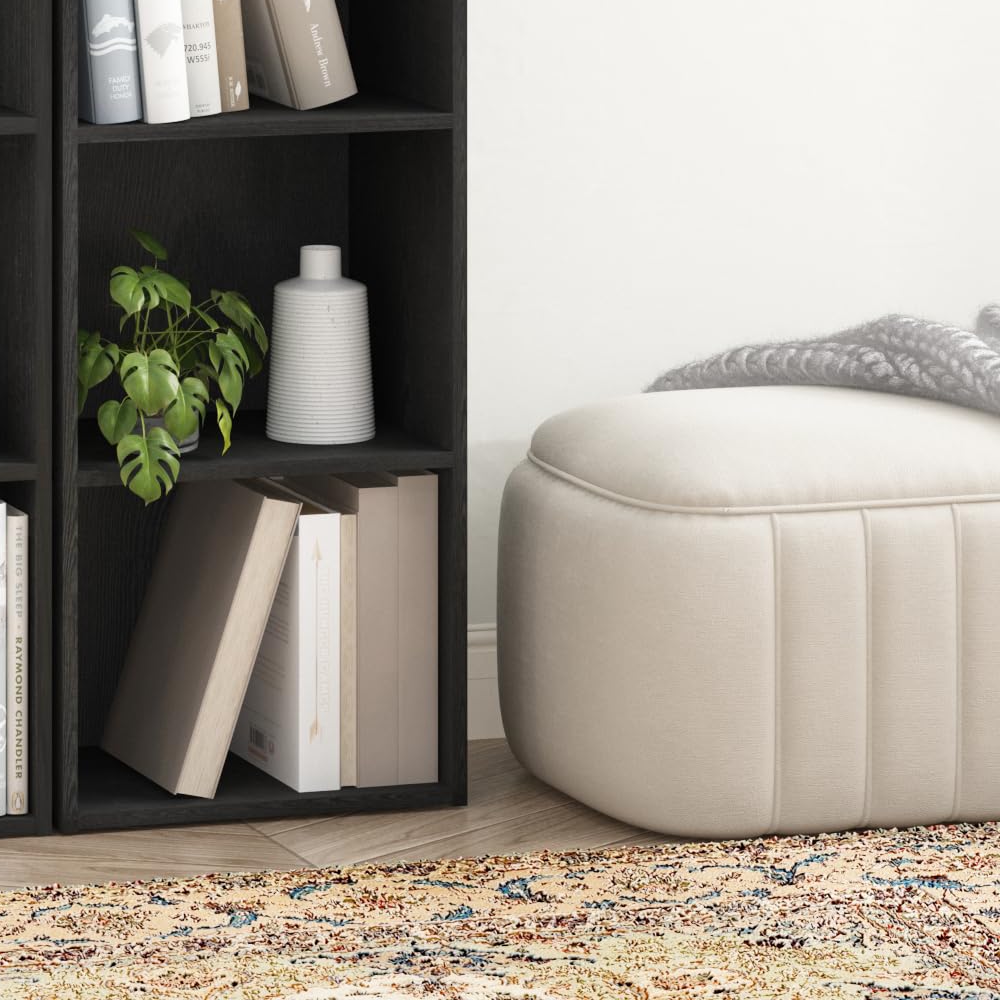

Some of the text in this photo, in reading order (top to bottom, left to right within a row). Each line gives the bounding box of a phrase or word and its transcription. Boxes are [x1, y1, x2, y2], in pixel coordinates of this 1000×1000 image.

[184, 42, 212, 52] 720.945
[309, 23, 331, 88] Andrew Brown
[15, 526, 23, 618] THE BIG SLEEP
[15, 637, 23, 779] RAYMOND CHANDLER
